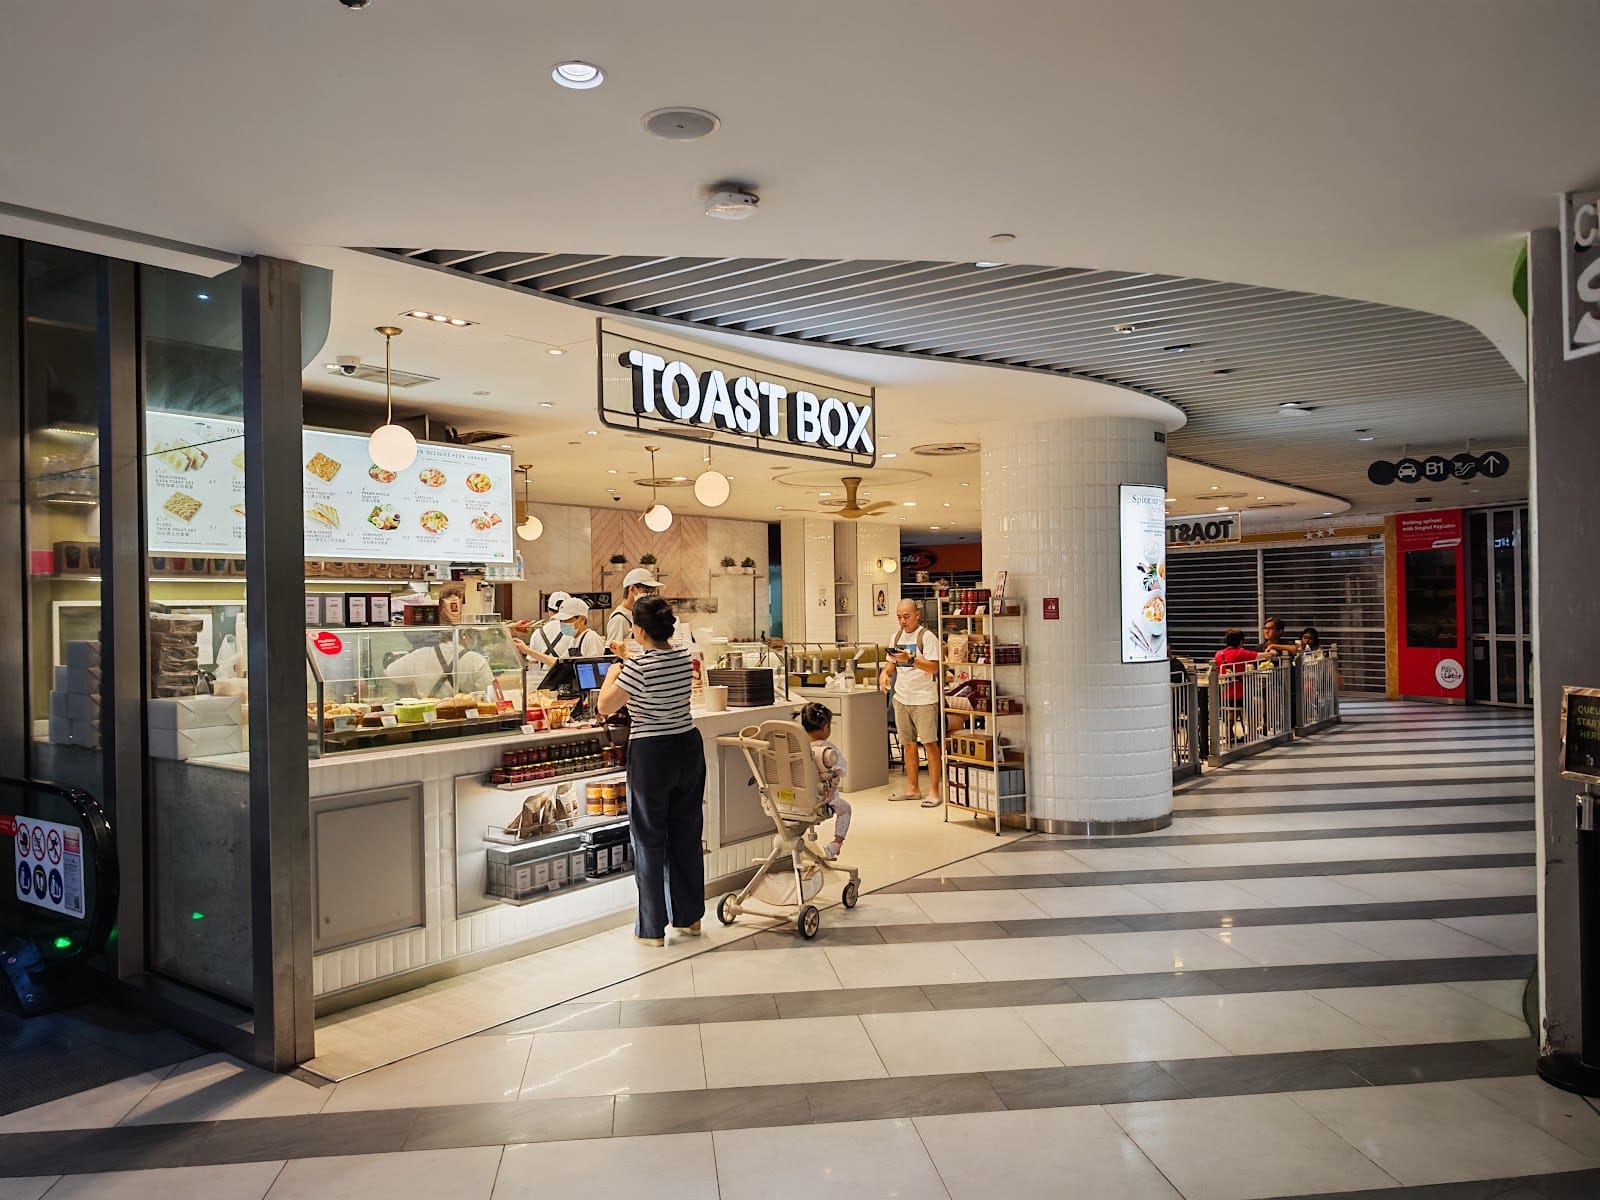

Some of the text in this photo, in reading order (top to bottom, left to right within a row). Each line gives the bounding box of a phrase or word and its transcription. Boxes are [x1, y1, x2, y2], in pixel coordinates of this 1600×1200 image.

[628, 349, 875, 454] TOAST BOX
[1425, 461, 1444, 475] B1
